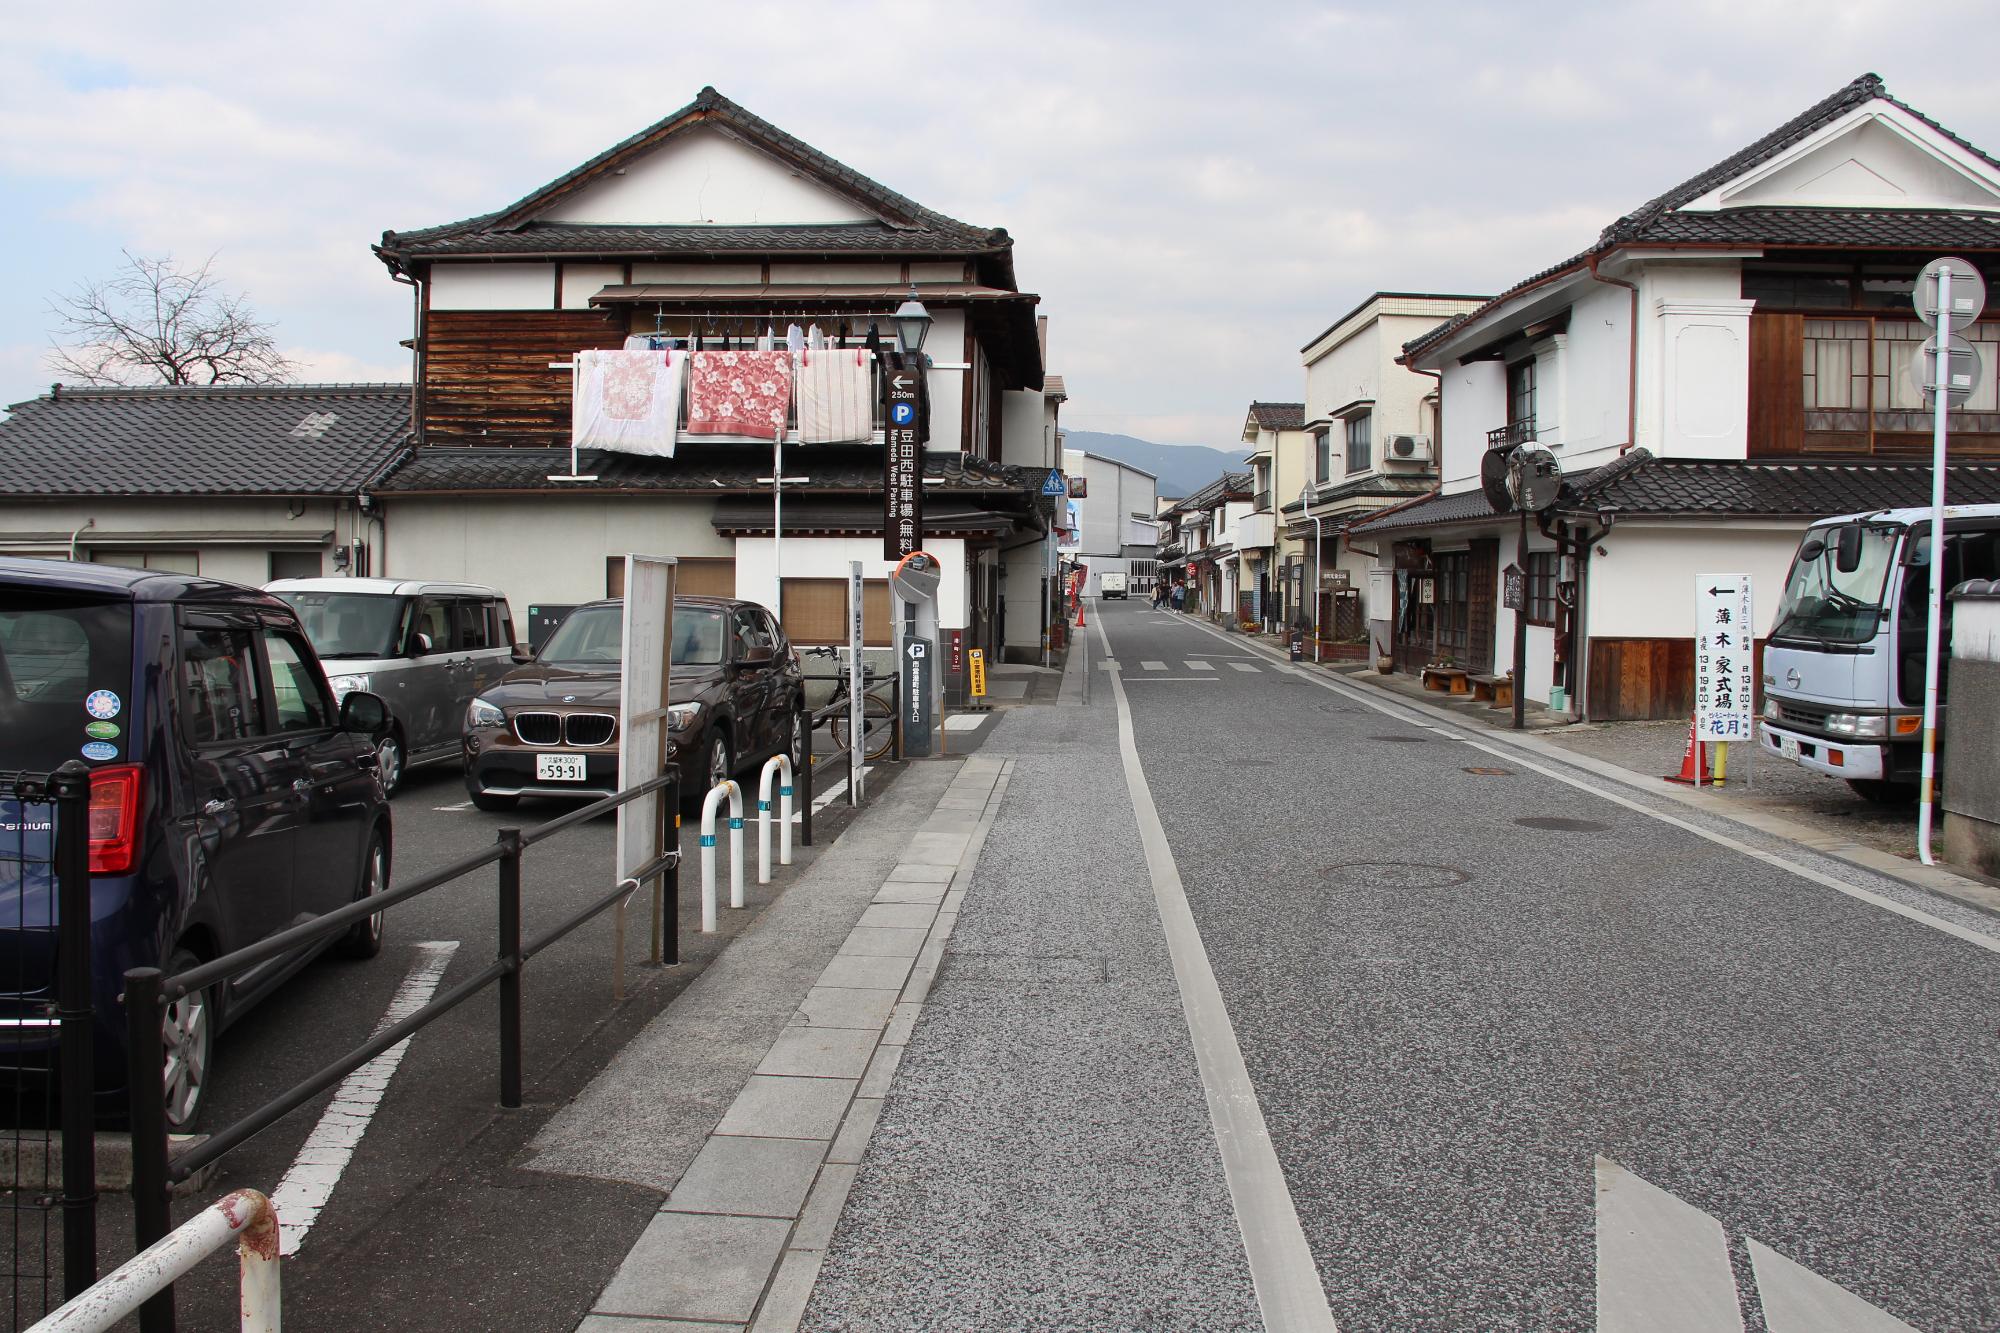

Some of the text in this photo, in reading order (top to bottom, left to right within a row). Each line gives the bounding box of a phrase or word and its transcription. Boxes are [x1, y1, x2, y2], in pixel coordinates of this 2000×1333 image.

[891, 391, 915, 399] 250m
[897, 405, 909, 421] P
[889, 429, 898, 518] Mameda West Parking
[1715, 608, 1733, 709] 薄木家式場
[1709, 720, 1739, 735] 花月
[548, 765, 581, 778] 59-91
